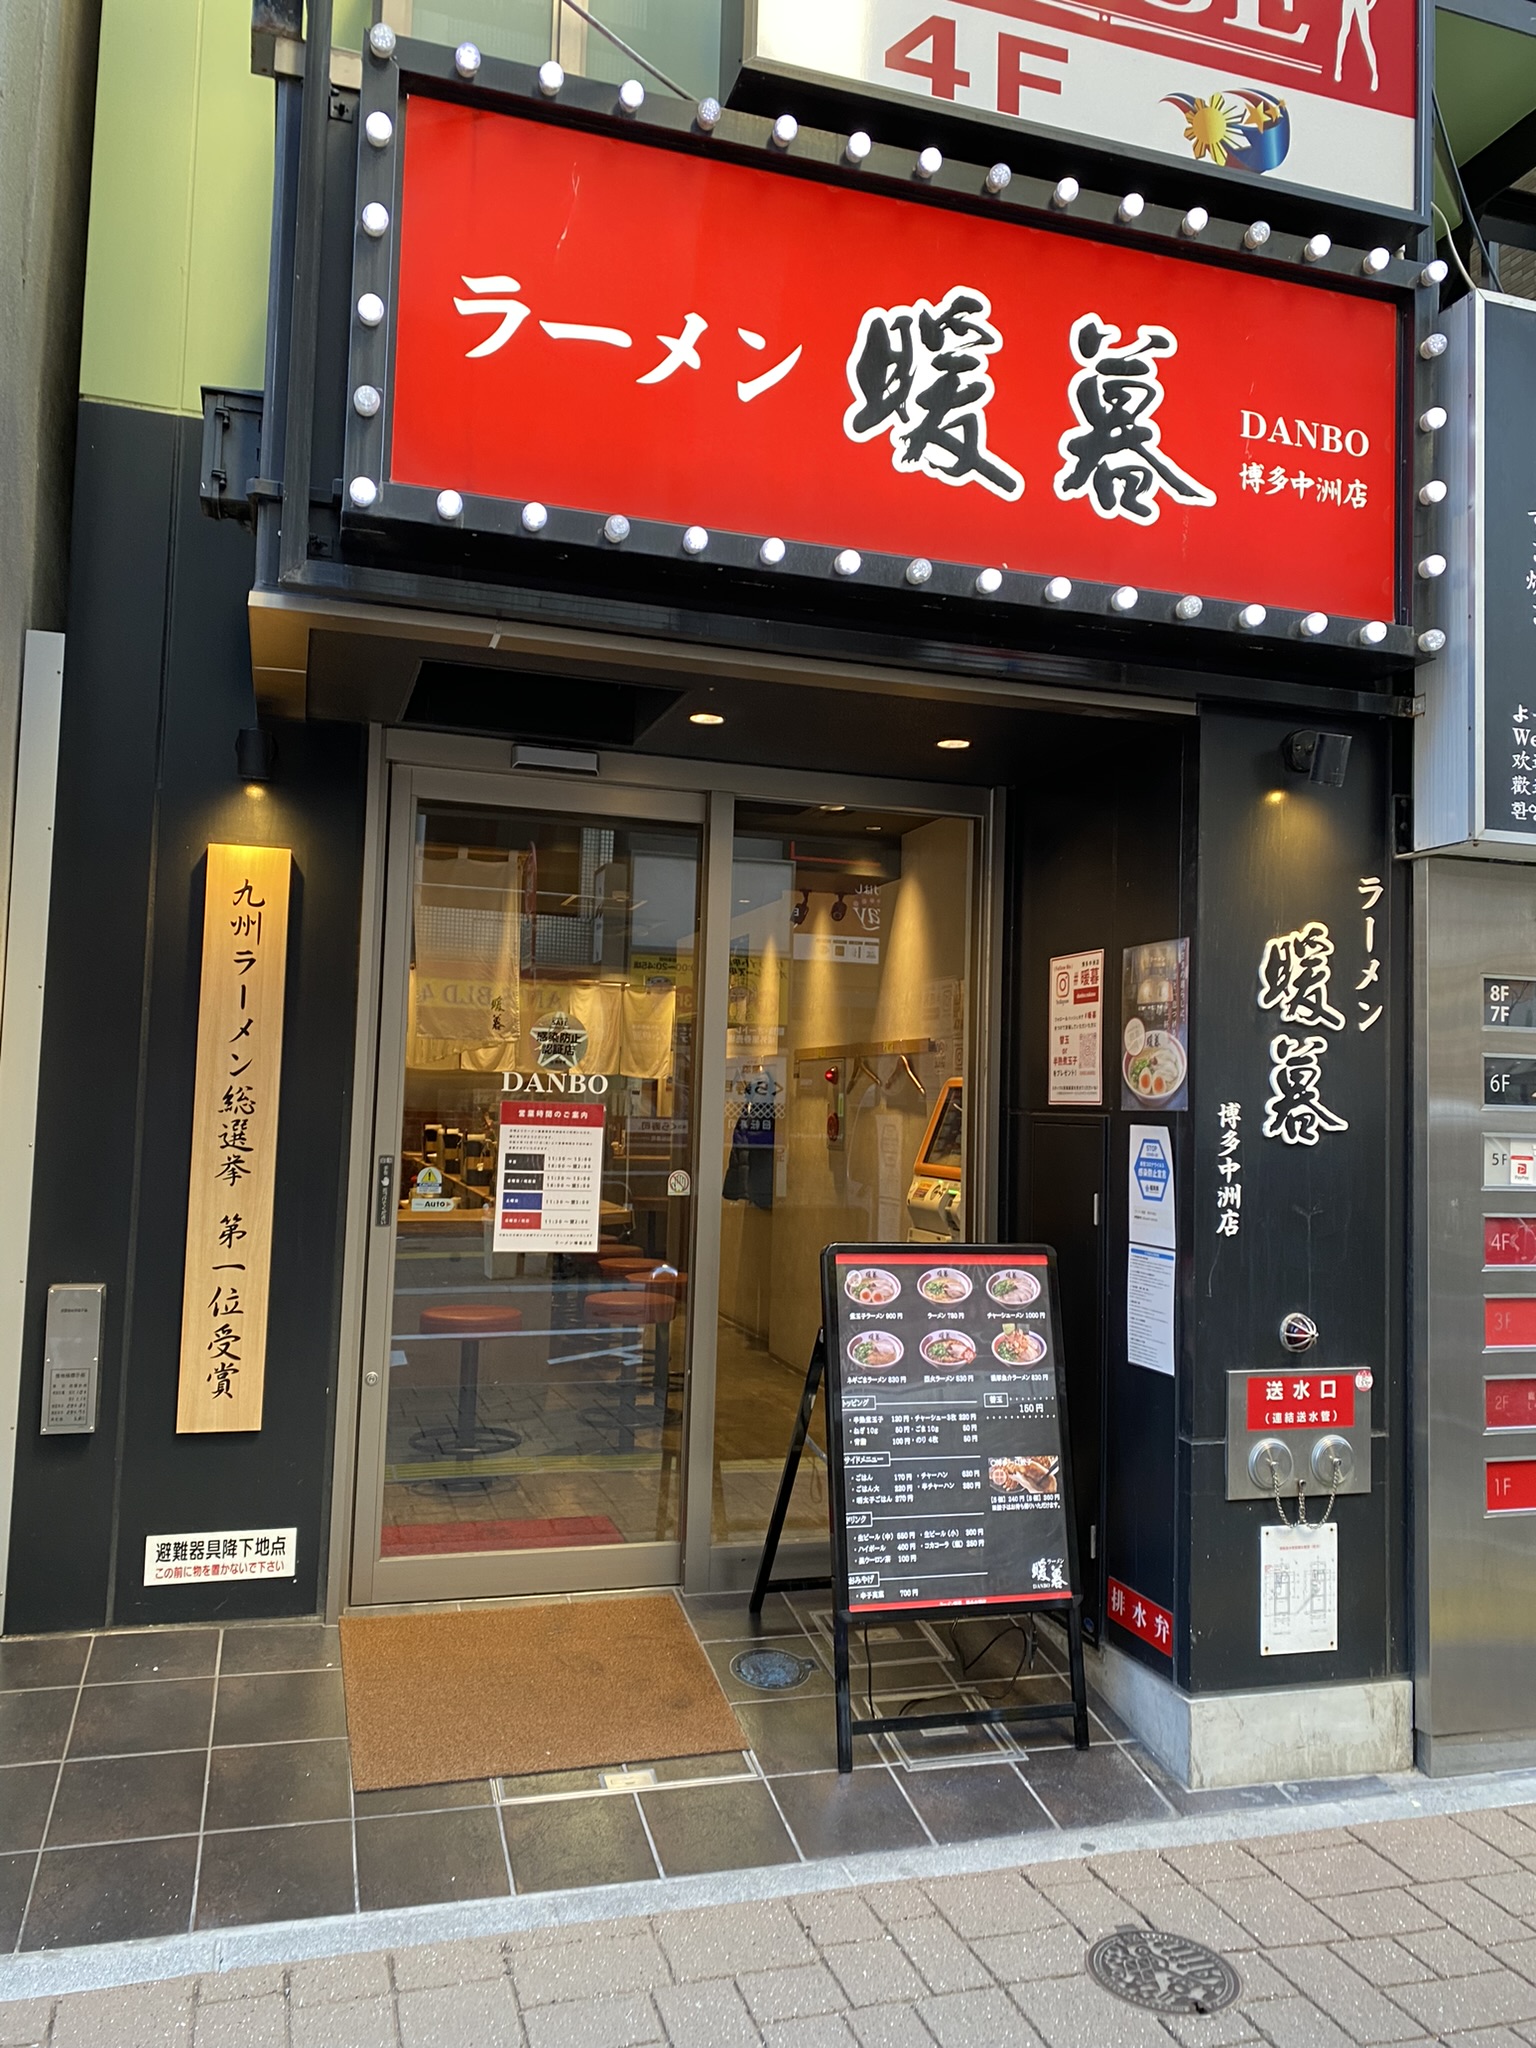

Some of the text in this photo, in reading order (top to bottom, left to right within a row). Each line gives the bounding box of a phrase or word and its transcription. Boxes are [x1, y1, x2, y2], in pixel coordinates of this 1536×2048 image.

[884, 15, 1069, 116] 4F
[452, 274, 1218, 527] ラーメン 暖暮
[1239, 410, 1370, 458] DANBO
[1238, 462, 1368, 509] 博多中洲店
[1512, 704, 1536, 723] よ
[1355, 875, 1384, 1032] ラーメン
[1489, 985, 1510, 1002] 8F
[1490, 1005, 1510, 1022] 7F
[1257, 921, 1349, 1146] 暖暮
[501, 1072, 609, 1095] DANBO
[1490, 1074, 1511, 1093] 6F
[518, 1109, 588, 1119] 営業時間のご案内
[206, 877, 266, 1400] 九州ラーメン総選挙 第一位受賞
[1216, 1101, 1242, 1237] 博多中洲店
[1491, 1153, 1508, 1166] 5F
[1490, 1232, 1510, 1251] 4F
[927, 1312, 946, 1320] ラーメン
[986, 1312, 1025, 1320] チャーシューメン
[1494, 1312, 1512, 1332] 3F
[1265, 1380, 1337, 1401] 送水口
[1495, 1395, 1509, 1411] 2F
[844, 1456, 884, 1465] サイドメニュー
[855, 1473, 874, 1481] ごはん
[920, 1471, 948, 1479] チャーハン
[855, 1485, 880, 1493] ごはん大
[1494, 1478, 1512, 1496] 1F
[155, 1536, 287, 1563] 避難器具降下地点
[857, 1544, 886, 1552] ハイボール
[155, 1561, 285, 1579] この前に物を置かないで下さい
[848, 1575, 875, 1585] おみやげ
[1111, 1586, 1170, 1644] 排水弁
